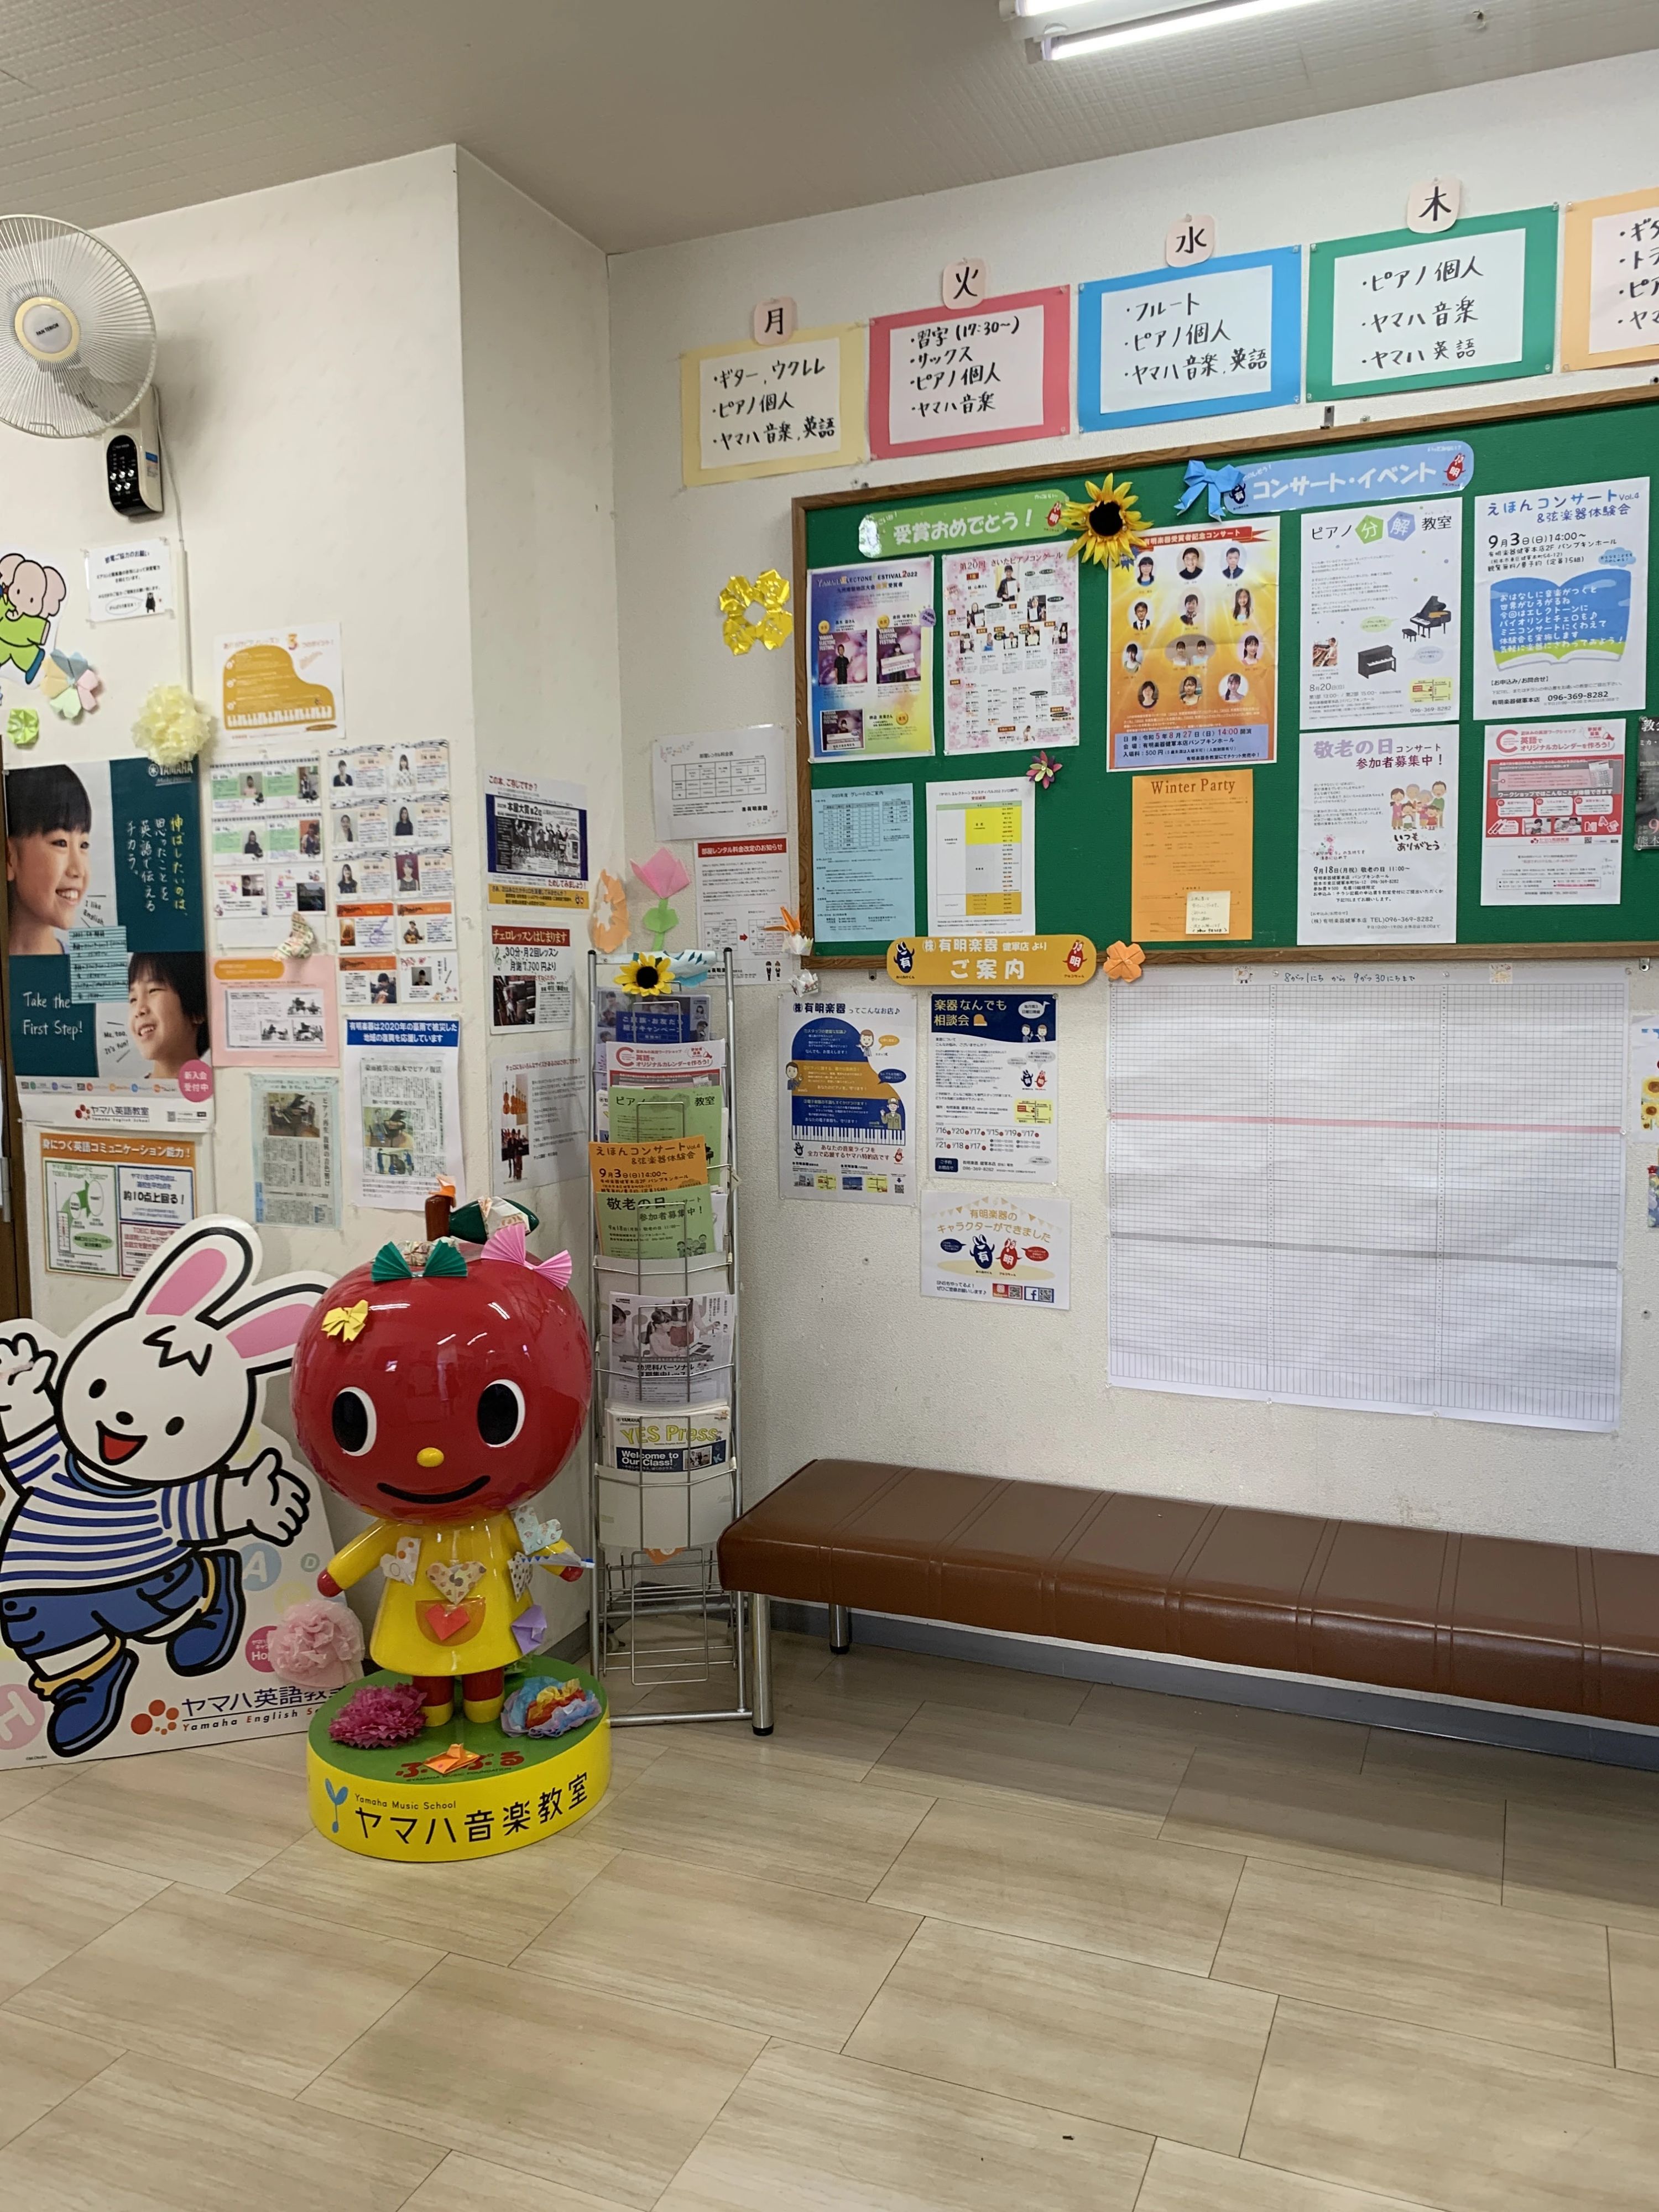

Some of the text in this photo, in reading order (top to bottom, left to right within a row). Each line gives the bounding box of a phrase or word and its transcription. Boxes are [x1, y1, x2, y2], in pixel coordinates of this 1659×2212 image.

[1418, 186, 1452, 221] 木
[1175, 226, 1207, 253] 水
[952, 266, 979, 300] 火
[764, 307, 785, 336] 月
[1253, 462, 1437, 499] コンサート・イベント
[1487, 488, 1618, 517] えほんコンサート
[1537, 503, 1631, 524] &弦楽器体験会
[892, 508, 1032, 545] 受賞おめでとう！
[1500, 586, 1597, 602] おはなしに音楽がつくと
[1499, 604, 1588, 618] 今回はエレクトーンに
[1500, 598, 1570, 611] 世界がひろがるね
[1500, 620, 1606, 635] ミニコンサートにくわえて
[1499, 630, 1578, 644] 体験会も実施します
[1548, 691, 1609, 701] 096-369-8282
[1313, 738, 1442, 759] 敬老の日 コンサート
[1356, 754, 1443, 769] 参加者募集中！
[1151, 778, 1236, 794] Winter Party
[1394, 833, 1418, 842] いつも
[1396, 841, 1441, 852] ありがとう
[493, 930, 567, 943] チェロレッスンはじまります
[1003, 942, 1029, 952] 健軍店
[1070, 956, 1082, 967] 明
[950, 959, 1024, 979] ご案内
[23, 992, 71, 1009] Take the
[934, 999, 1006, 1011] 楽器なんでも
[934, 1014, 969, 1026] 相談会
[23, 1020, 83, 1041] First Step!
[695, 1096, 715, 1106] 教室
[91, 1106, 150, 1116] ヤマハ英語教室
[596, 1142, 686, 1156] えほんコンサート
[807, 1151, 889, 1160] 全力で応援するヤマハ特約店です
[821, 1145, 875, 1153] あなたの音楽ライフを
[123, 1191, 185, 1204] 約10点上回る！
[970, 1209, 1018, 1221] 有明楽器の
[937, 1222, 1051, 1243] キャラクターができました
[978, 1251, 988, 1262] 有
[1003, 1254, 1014, 1266] 明
[620, 1425, 719, 1444] YES Press
[621, 1450, 667, 1459] Welcome
[242, 1550, 267, 1583] A
[305, 1556, 316, 1569] D
[182, 1710, 299, 1731] Yamaha English
[354, 1793, 456, 1810] Yamaha Music School
[355, 1772, 588, 1844] ヤマハ音楽教室
